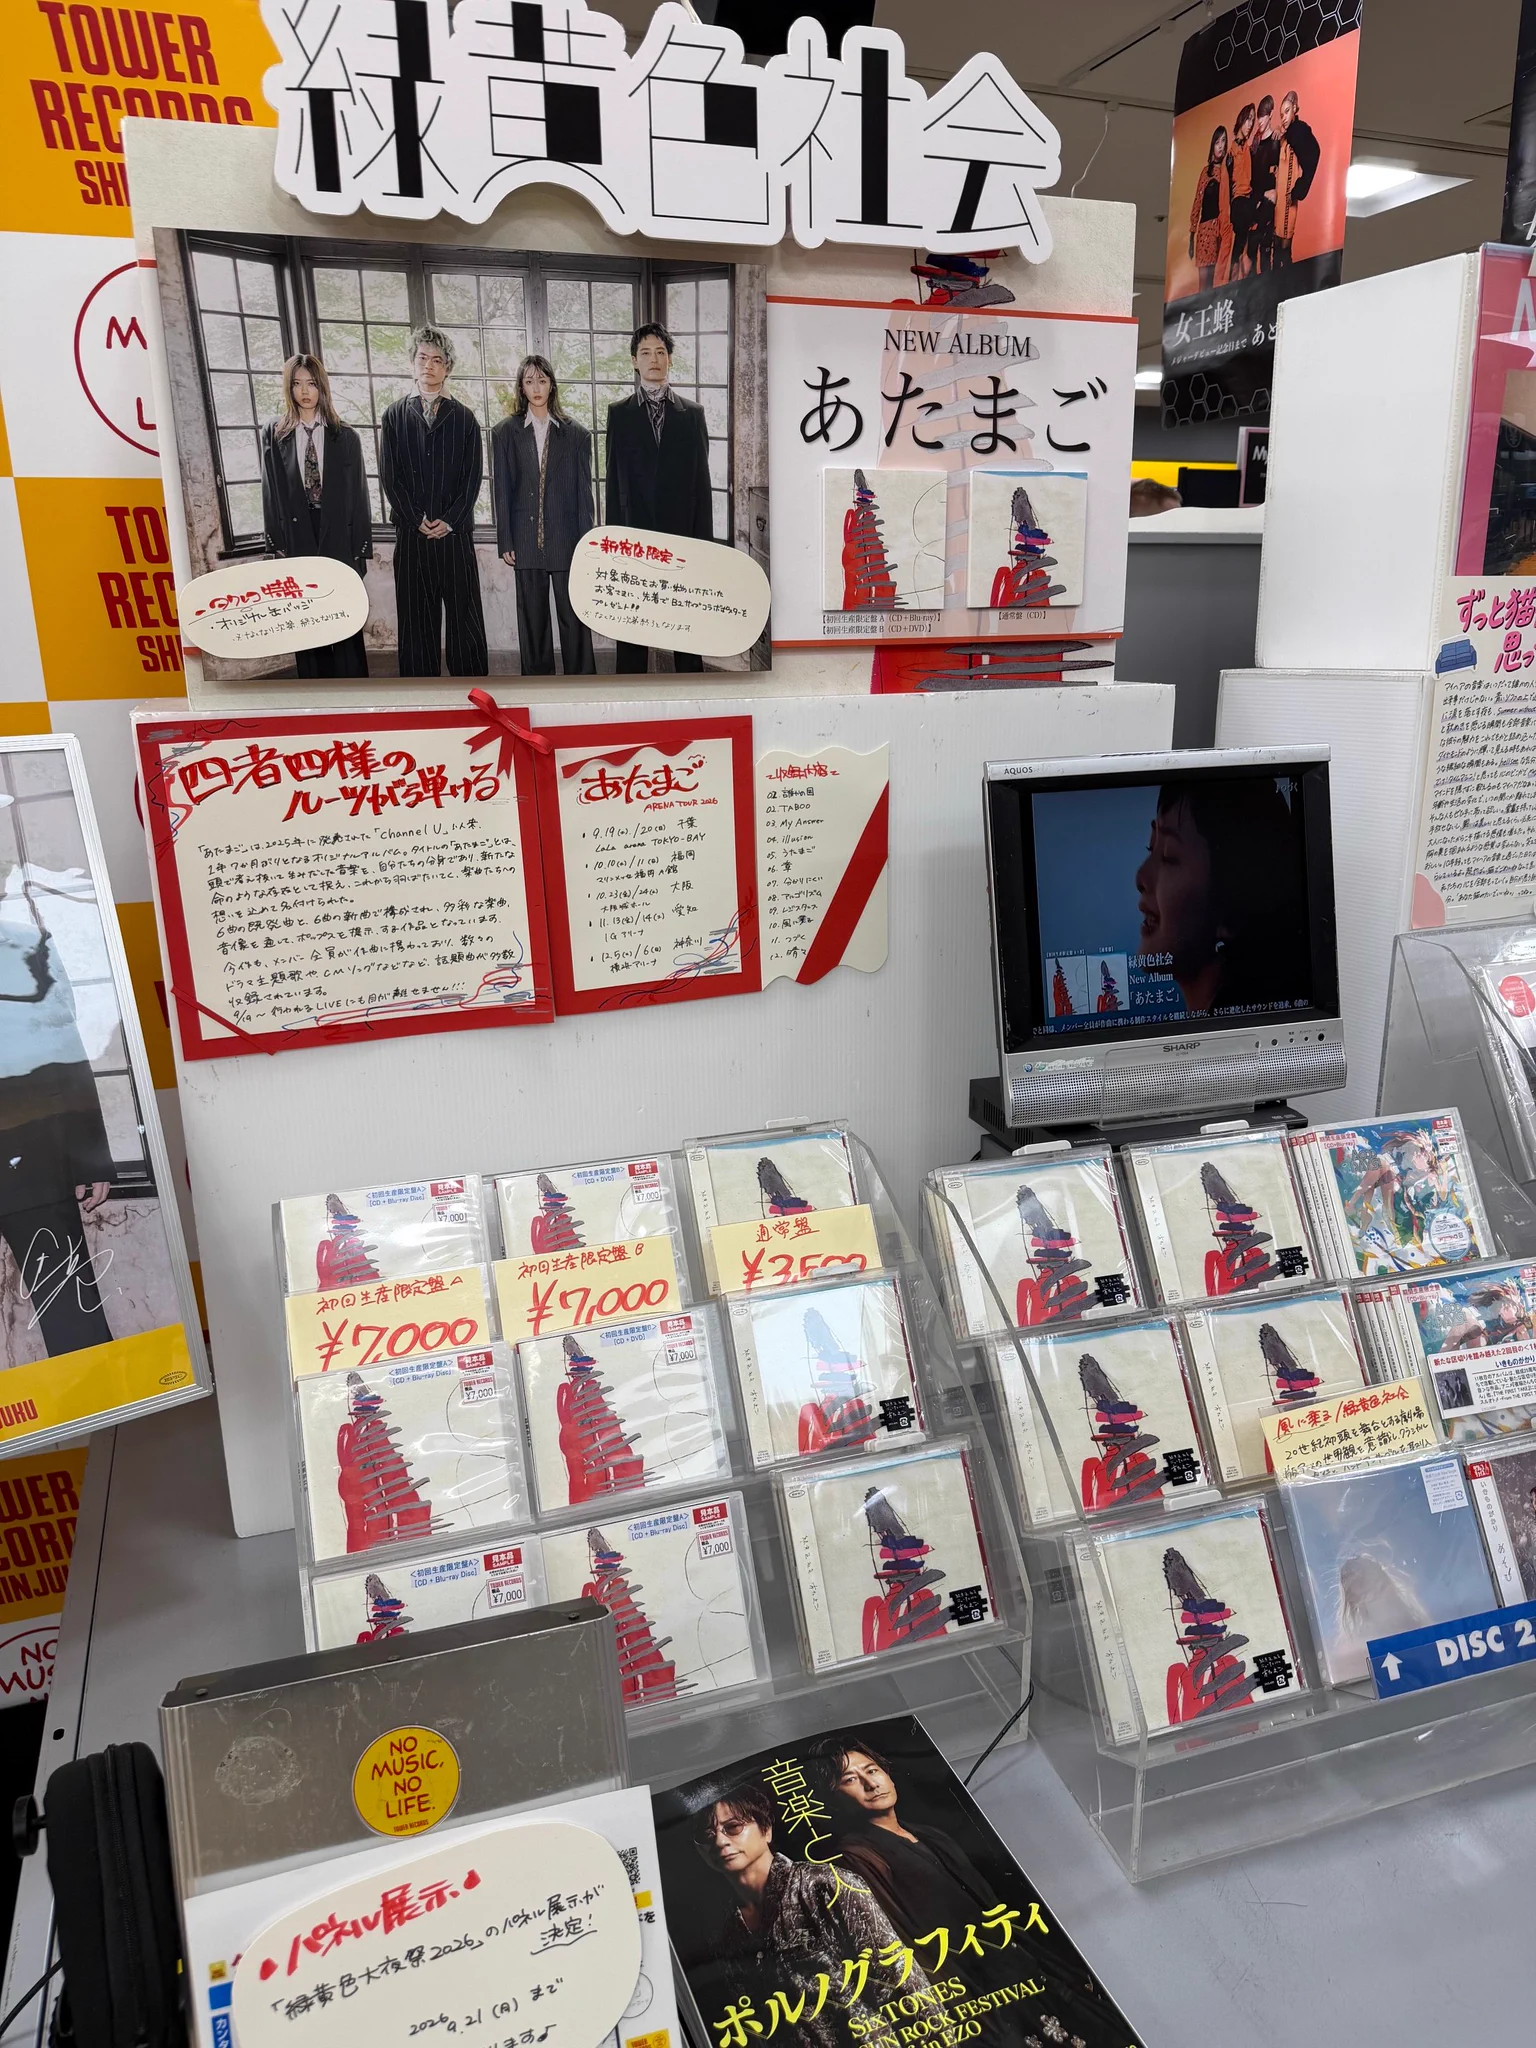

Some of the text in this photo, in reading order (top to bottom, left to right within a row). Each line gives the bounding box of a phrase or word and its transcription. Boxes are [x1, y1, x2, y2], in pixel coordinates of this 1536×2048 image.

[37, 1, 220, 86] TOWER
[284, 0, 1047, 247] 緑黄色社会
[1172, 299, 1235, 348] 女王蜂
[884, 328, 1031, 358] NEW ALBUM
[800, 366, 1108, 454] あたまご
[600, 535, 674, 564] 新宿店限定
[179, 740, 417, 805] 四者四様の
[580, 757, 705, 804] あたまご
[1004, 766, 1033, 775] AQUOS
[282, 763, 501, 822] ルーツが弾ける
[643, 798, 718, 813] ARENA TOUR 2026
[677, 816, 698, 829] 千葉
[670, 849, 696, 862] 福岡
[670, 880, 694, 892] 大阪
[671, 904, 699, 918] 愛知
[672, 936, 703, 951] 神奈川
[1128, 952, 1174, 969] 緑黄色社会
[1129, 972, 1174, 985] New Album
[1130, 988, 1181, 1005] 「あたまご」
[1162, 1042, 1201, 1053] SHARP
[636, 1191, 659, 1201] ¥7,000
[438, 1212, 464, 1223] ¥7,000
[756, 1217, 820, 1243] 通常盤
[528, 1279, 670, 1336] ¥7,000
[315, 1316, 479, 1372] ¥7,000
[669, 1350, 694, 1362] ¥7,000
[465, 1387, 494, 1400] ¥7,000
[702, 1541, 730, 1555] ¥7,000
[493, 1589, 523, 1604] ¥7,000
[1434, 1618, 1536, 1668] DISC 2
[390, 1736, 418, 1757] NO
[371, 1749, 444, 1781] MUSIC,
[394, 1775, 422, 1797] NO
[386, 1793, 436, 1819] LIFE.
[761, 1756, 871, 1909] 音楽と人
[287, 1880, 460, 1976] パネル展示
[713, 1900, 1051, 2048] ポルノグラフィティ
[847, 1975, 967, 2039] SixTONES
[899, 1977, 1046, 2044] ROCK FESTIVAL
[939, 2020, 983, 2048] EZO
